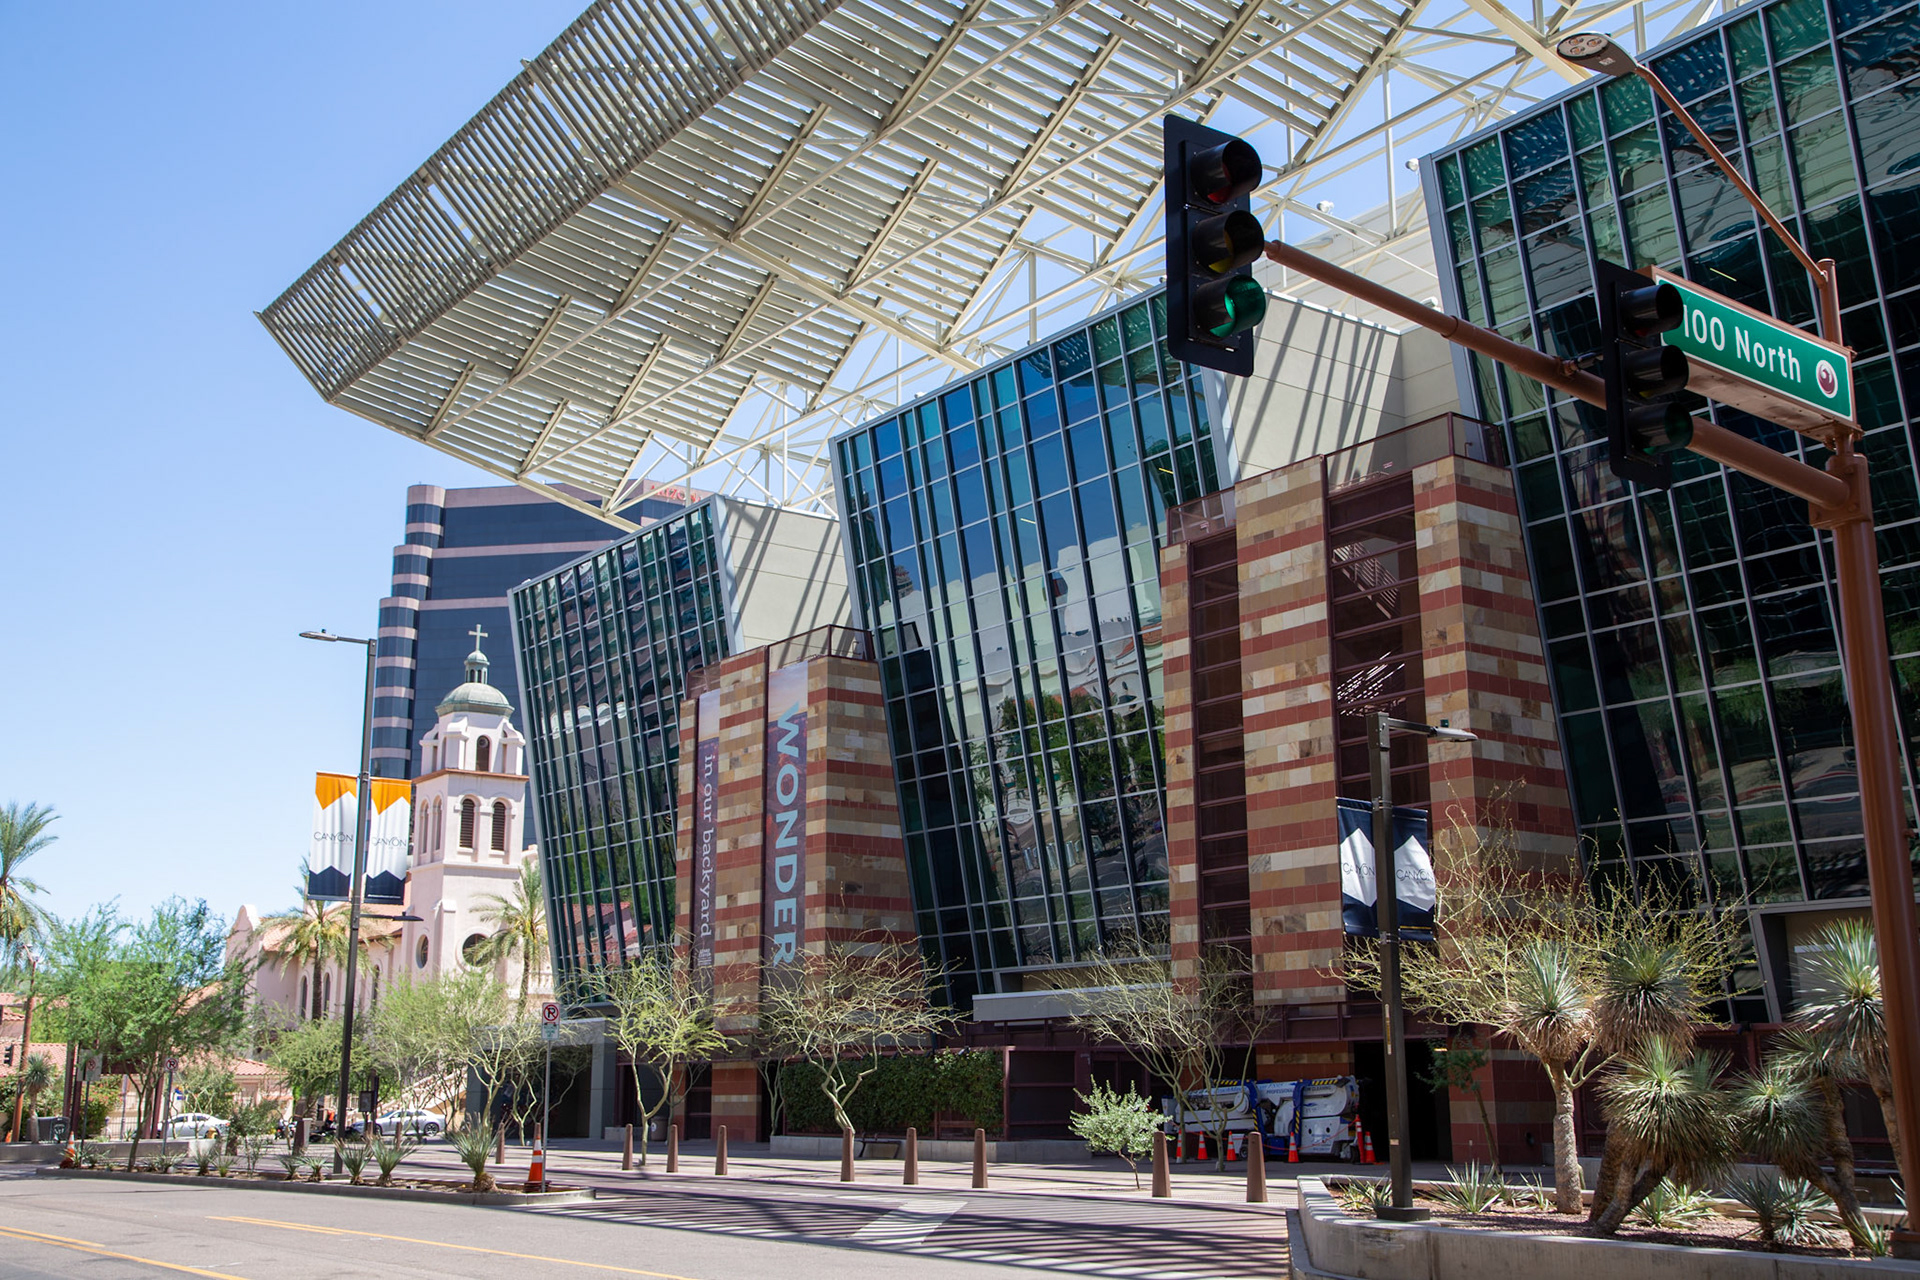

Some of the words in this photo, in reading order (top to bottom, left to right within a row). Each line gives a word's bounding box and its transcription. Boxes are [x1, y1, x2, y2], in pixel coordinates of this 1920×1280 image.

[1683, 304, 1726, 352] 100
[1734, 326, 1802, 383] North
[704, 754, 716, 779] in
[702, 783, 715, 823] our
[313, 831, 354, 842] CANYON
[371, 836, 407, 847] CANYON
[772, 700, 800, 967] WONDER
[1342, 862, 1376, 876] CANYON
[1396, 868, 1435, 882] CANYON
[699, 827, 715, 938] backyard
